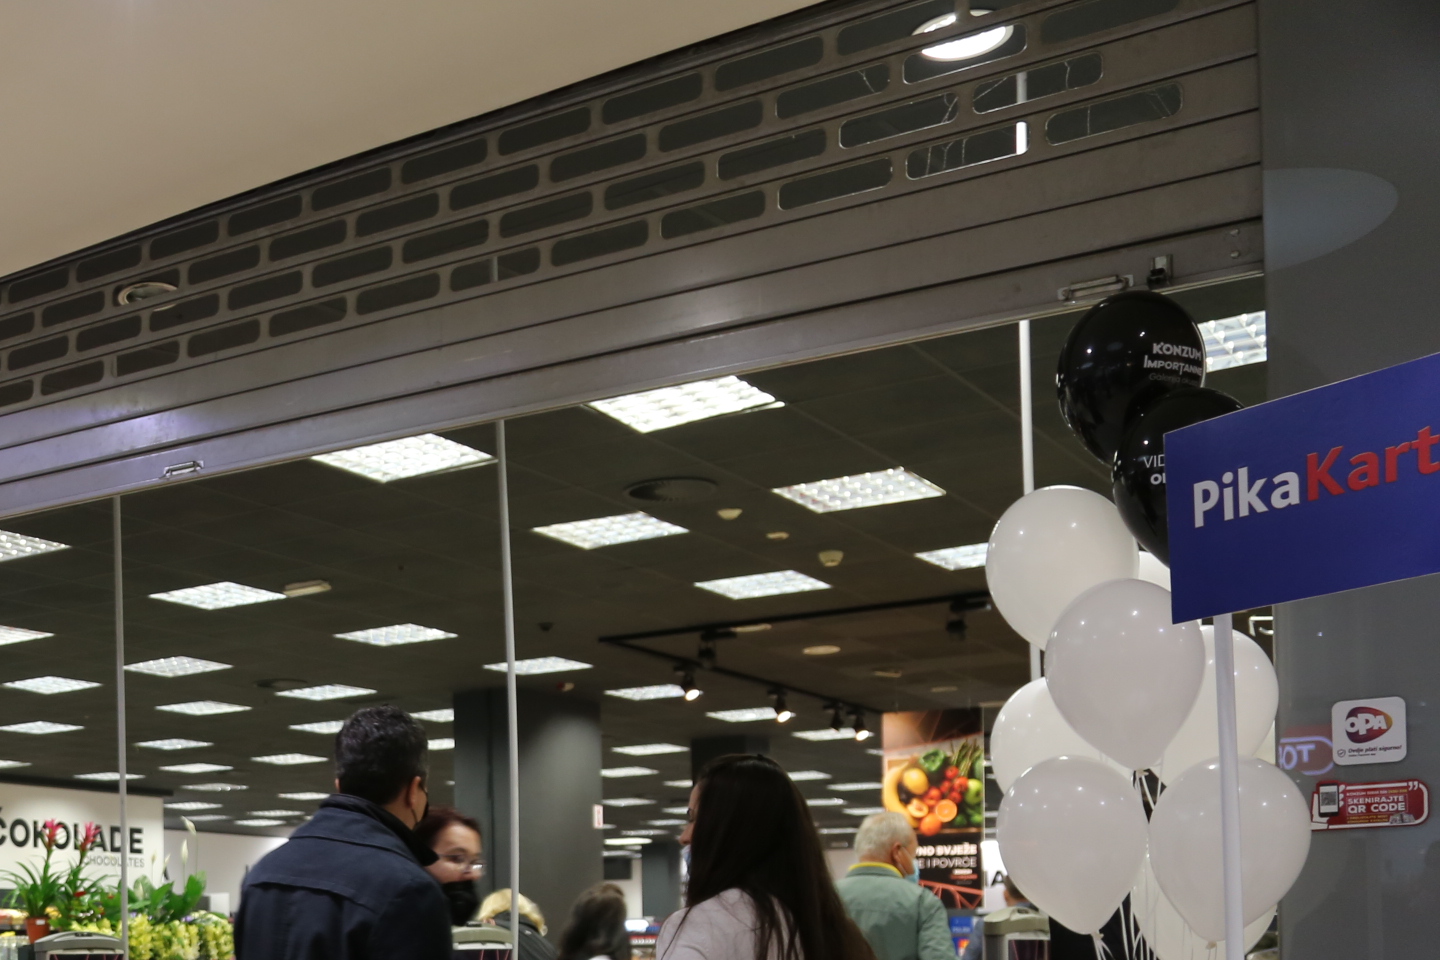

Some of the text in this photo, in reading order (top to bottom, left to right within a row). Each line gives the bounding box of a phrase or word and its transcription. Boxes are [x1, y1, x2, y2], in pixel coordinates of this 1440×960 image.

[1152, 342, 1201, 361] KONZUM
[1143, 355, 1202, 376] IMPORTANNE
[1193, 426, 1440, 528] PikaKart
[1345, 713, 1388, 735] OPA
[1348, 795, 1404, 805] SKENIRAJTE
[1348, 802, 1406, 814] QR CODE
[84, 855, 145, 868] CHOCOLTES
